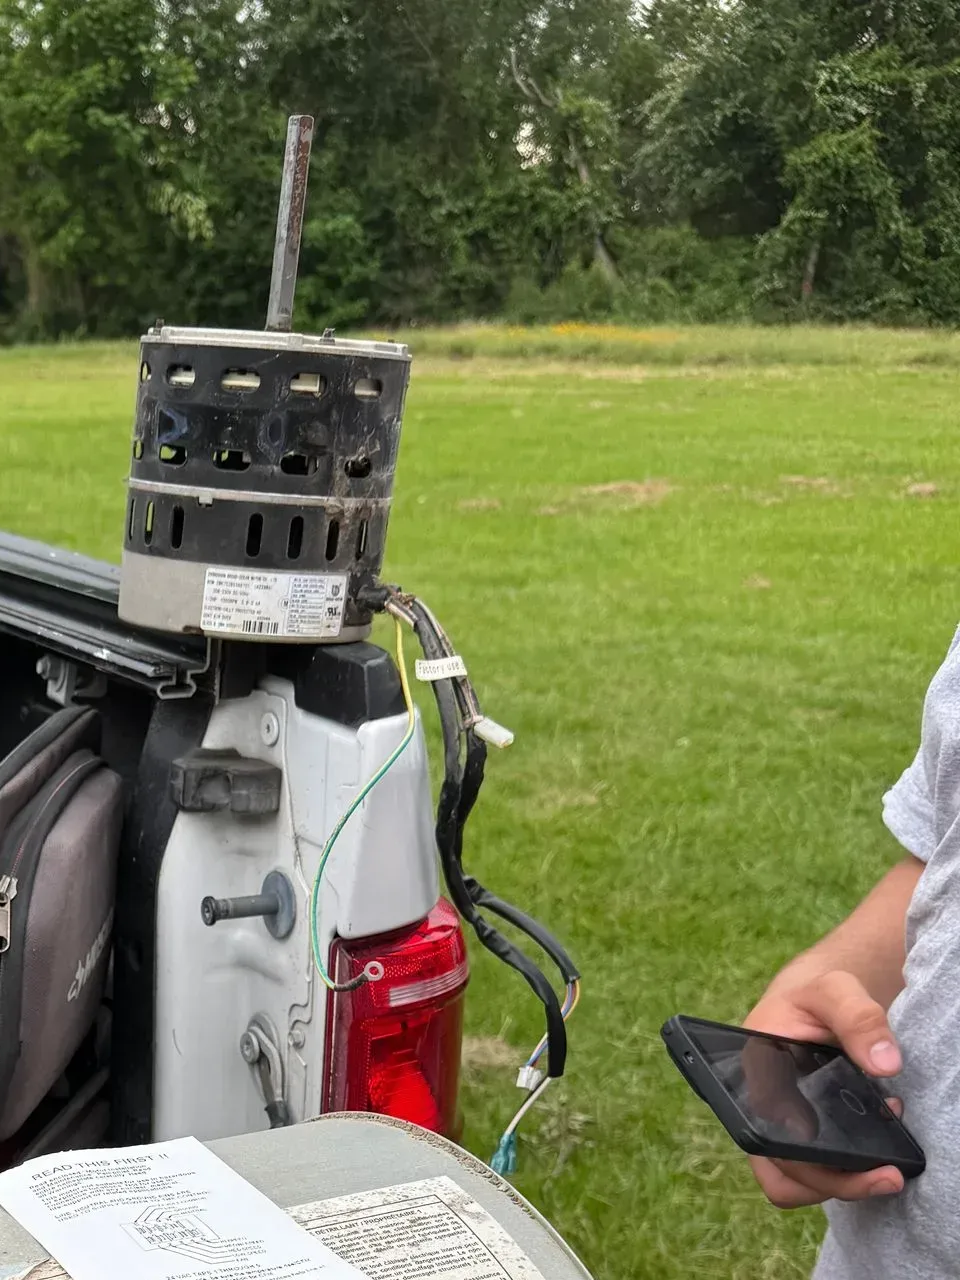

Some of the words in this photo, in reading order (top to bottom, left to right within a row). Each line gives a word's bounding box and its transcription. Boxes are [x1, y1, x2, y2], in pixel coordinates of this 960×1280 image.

[31, 1164, 76, 1181] READ
[74, 1160, 110, 1168] THIS
[113, 1155, 153, 1164] FIRST
